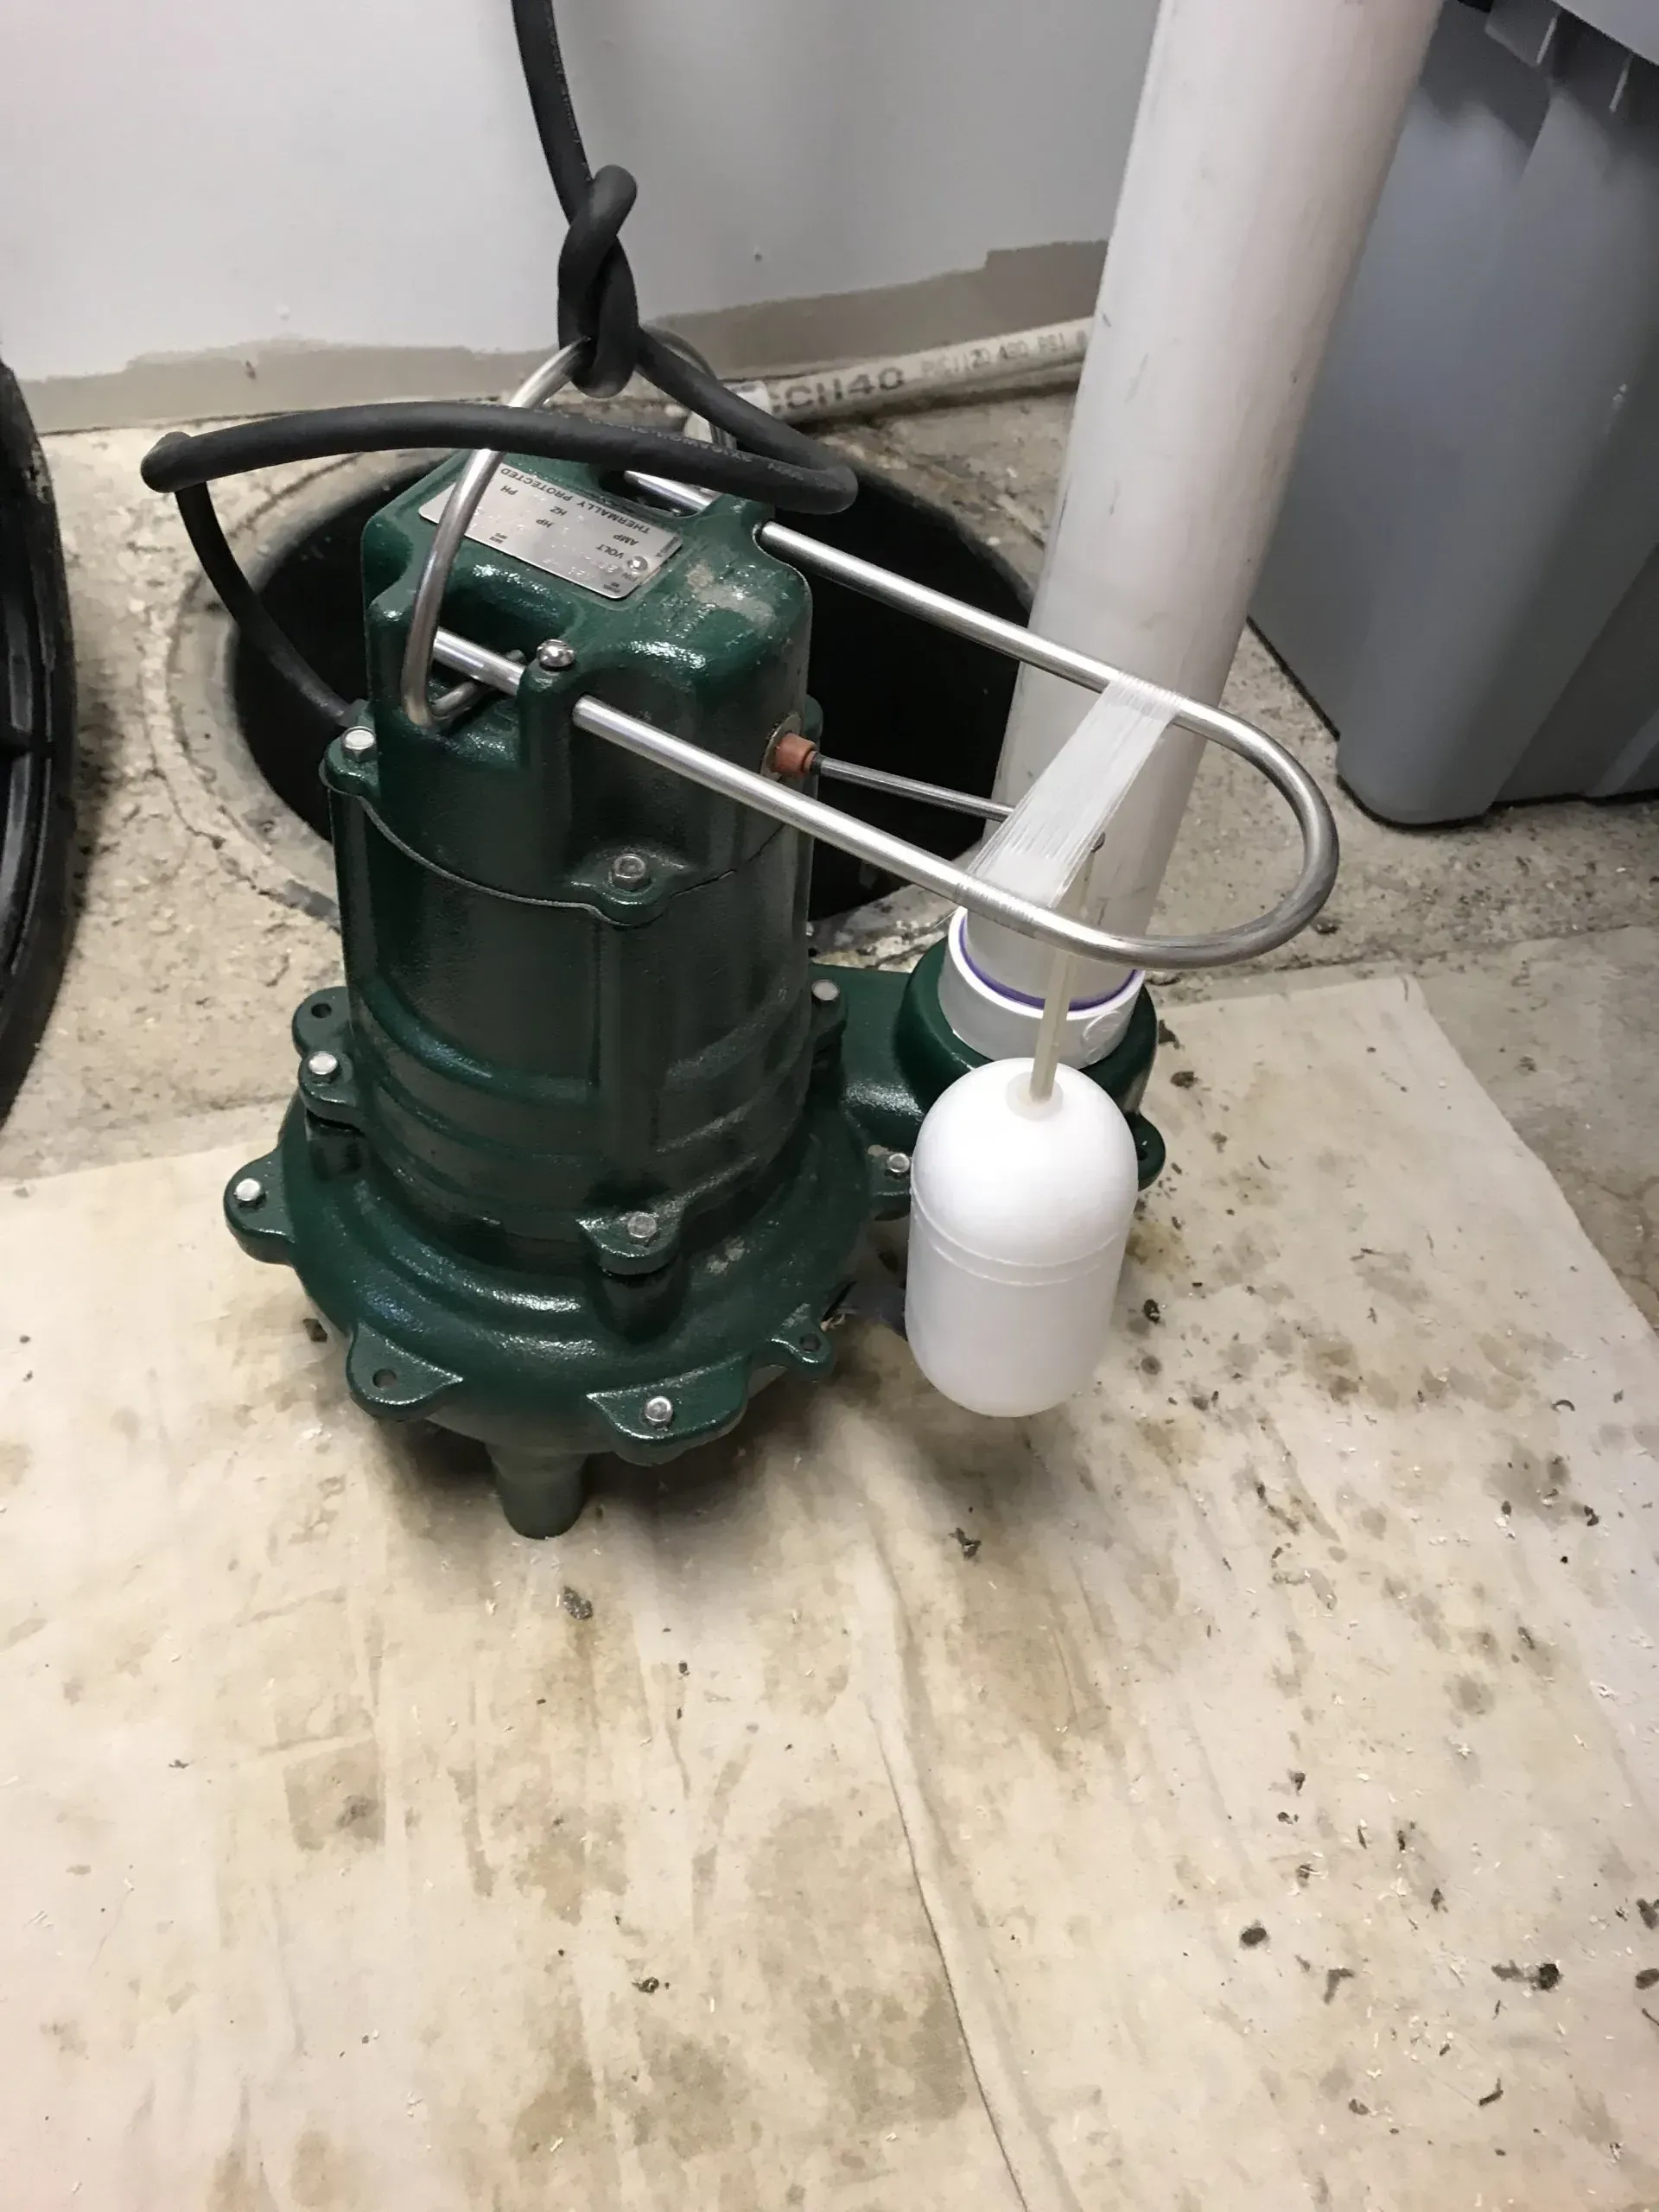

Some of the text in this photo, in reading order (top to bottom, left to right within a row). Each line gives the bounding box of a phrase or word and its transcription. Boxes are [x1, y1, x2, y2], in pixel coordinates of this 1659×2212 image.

[500, 485, 518, 495] PH
[500, 467, 651, 534] THERMALLY PROTECTED
[550, 505, 568, 516] HZ
[536, 518, 554, 528] HP
[613, 534, 639, 546] AMP
[595, 543, 624, 559] VOLT
